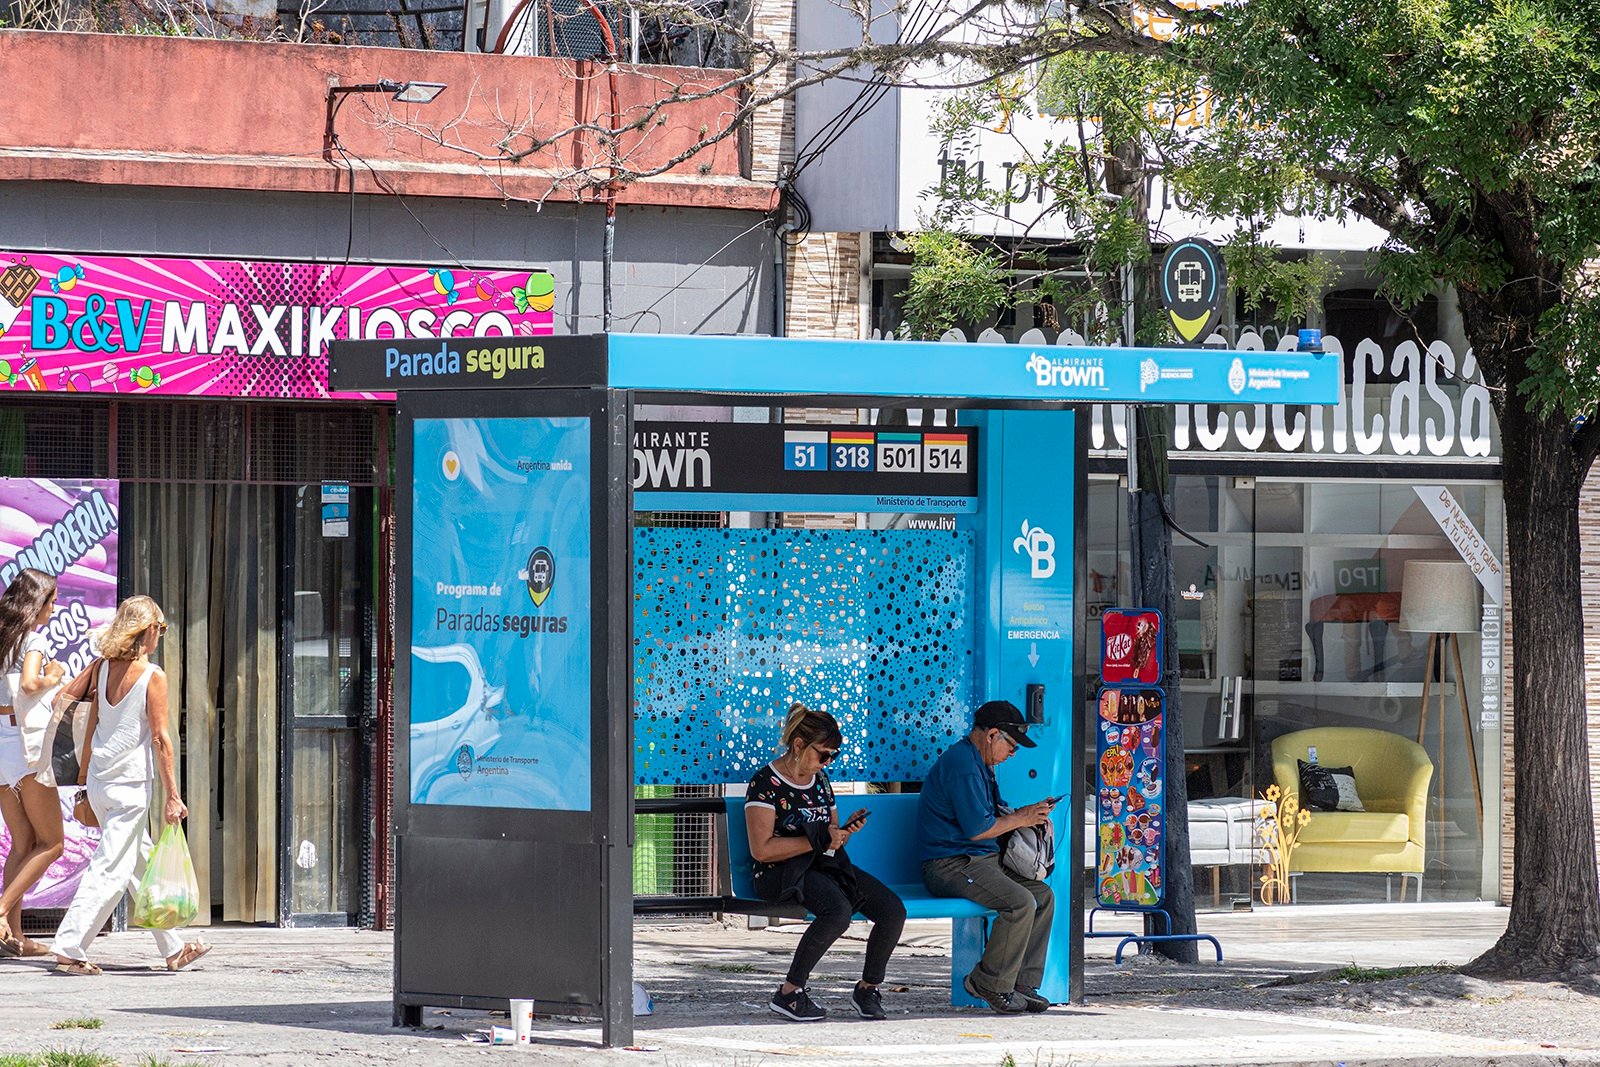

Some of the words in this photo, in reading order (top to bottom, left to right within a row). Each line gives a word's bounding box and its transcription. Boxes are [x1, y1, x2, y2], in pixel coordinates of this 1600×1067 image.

[31, 294, 151, 353] B&V
[385, 342, 460, 378] Parada
[466, 345, 545, 379] segura
[1052, 358, 1104, 366] ALMIRANTE
[1036, 359, 1104, 386] Brown
[1248, 378, 1281, 390] Argentina
[633, 431, 709, 447] MIRANTE
[517, 460, 550, 473] Argentina
[551, 459, 572, 470] unida
[794, 445, 817, 468] 51
[835, 446, 870, 469] 318
[883, 448, 916, 469] 501
[928, 448, 962, 470] 514
[633, 448, 711, 489] own
[876, 497, 914, 506] Ministerio
[916, 498, 925, 506] de
[926, 498, 967, 508] Transporte
[908, 517, 956, 530] www.livi
[1439, 490, 1451, 508] De
[1450, 505, 1479, 548] Nuestro
[1480, 545, 1501, 575] Taller
[1441, 516, 1450, 528] A
[1450, 524, 1461, 543] Tu
[1459, 538, 1485, 575] Living!
[436, 581, 487, 599] Programa
[489, 582, 502, 596] de
[42, 601, 89, 658] ESOS
[436, 607, 500, 632] Paradas
[502, 615, 568, 638] seguras
[1008, 630, 1060, 640] EMERGENCIA
[477, 754, 502, 762] Ministerio
[503, 755, 509, 763] de
[510, 756, 539, 765] Transporte
[477, 765, 509, 776] Argentina
